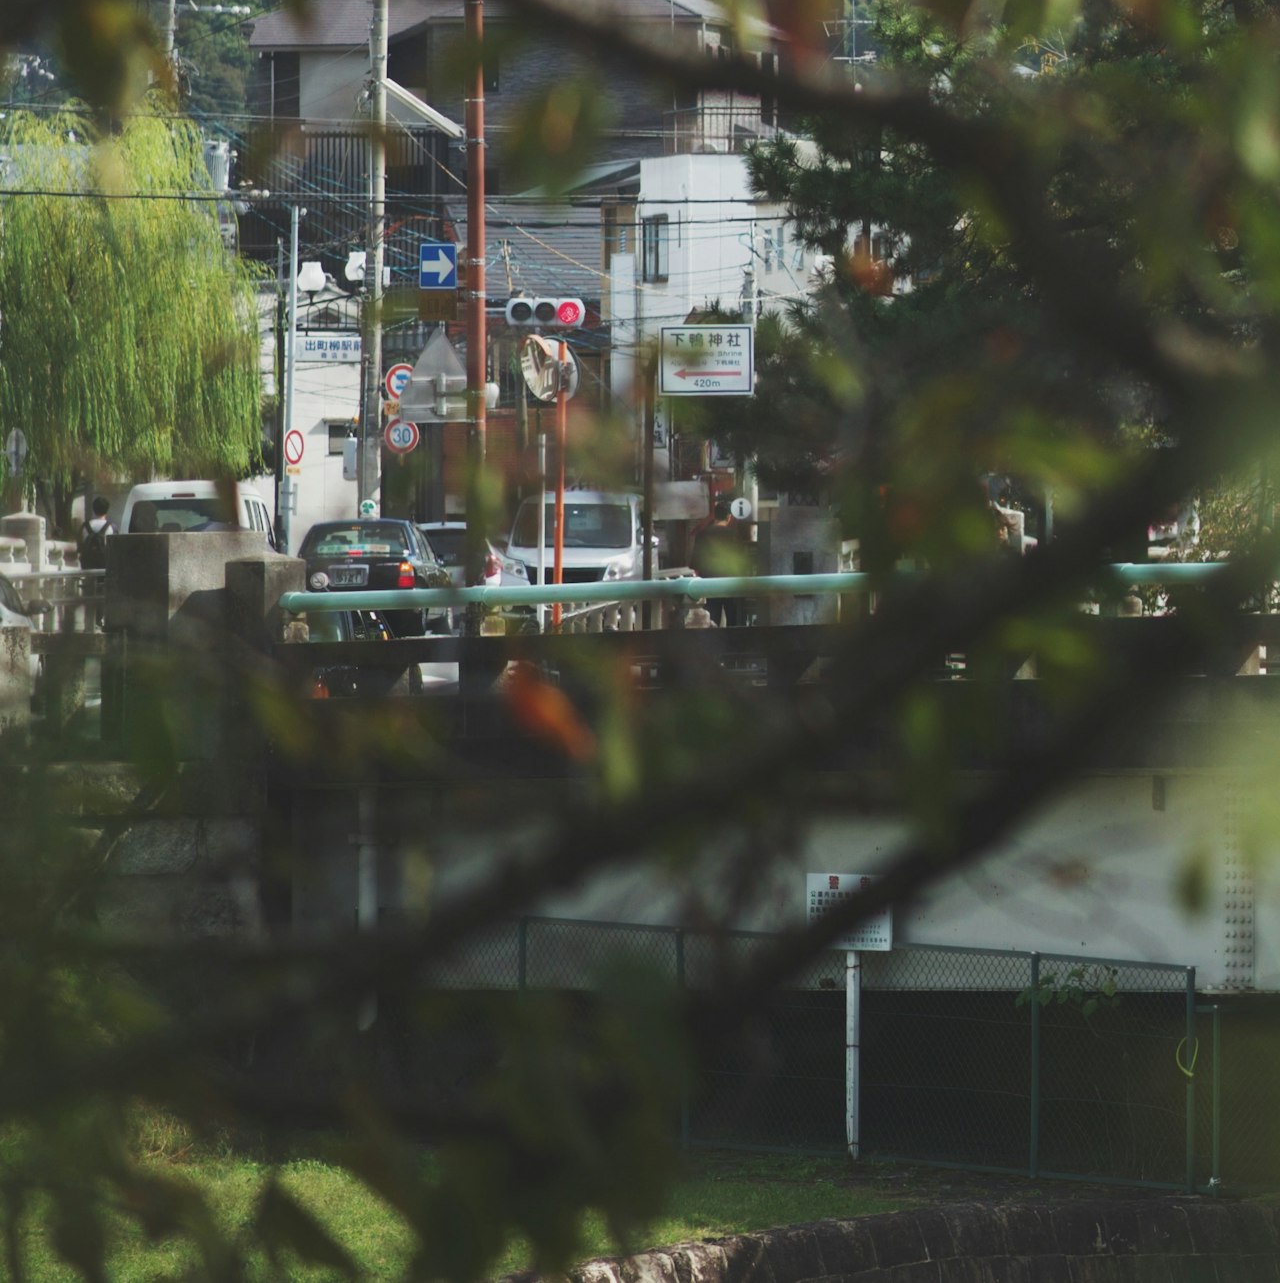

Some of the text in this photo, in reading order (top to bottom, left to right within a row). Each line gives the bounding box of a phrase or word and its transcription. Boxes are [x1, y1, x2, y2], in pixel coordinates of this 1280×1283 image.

[670, 332, 741, 347] 下鴨神社
[718, 349, 742, 357] Shrine
[693, 379, 721, 388] 420m
[393, 428, 411, 444] 30
